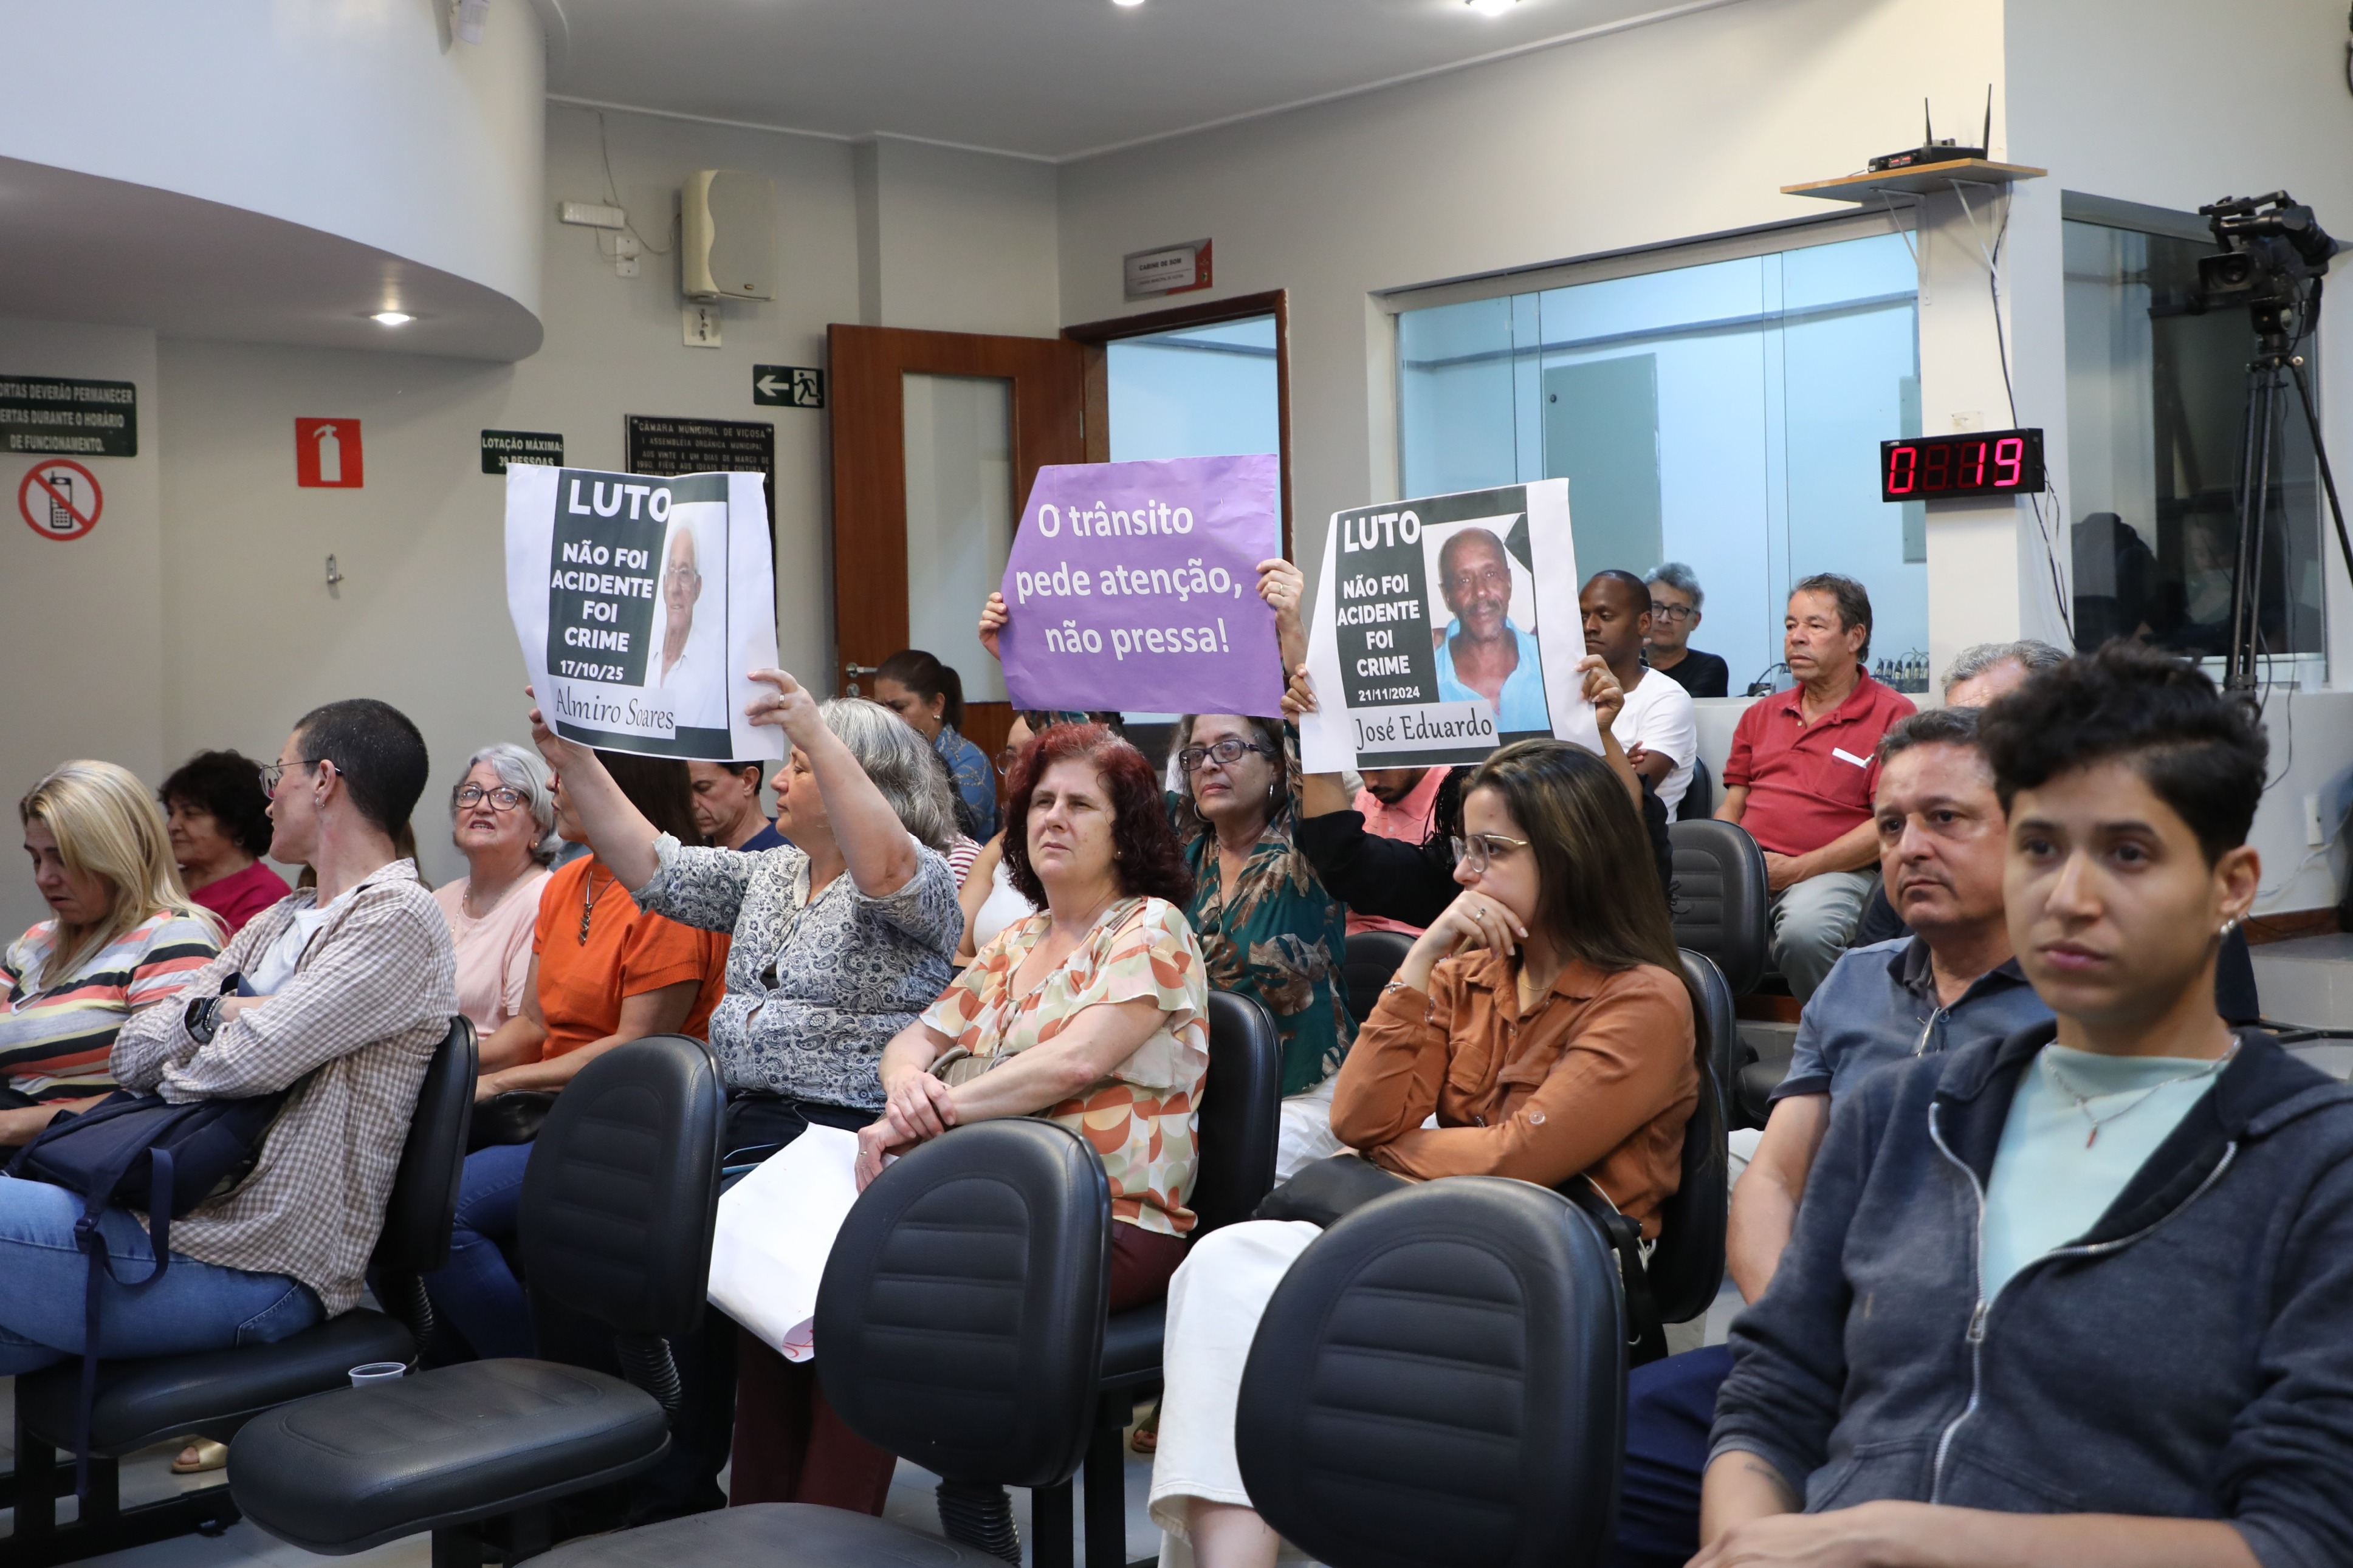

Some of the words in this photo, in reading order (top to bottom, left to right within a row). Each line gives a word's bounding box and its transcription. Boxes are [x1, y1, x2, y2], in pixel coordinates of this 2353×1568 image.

[1169, 258, 1182, 266] SOM
[30, 383, 72, 400] DEVERÃO
[74, 387, 133, 403] PERMANECER
[31, 409, 74, 425] DURANTE
[75, 412, 83, 425] O
[84, 409, 125, 428] HORÁRIO
[639, 420, 674, 433] CÂMARA
[678, 425, 718, 436] MUNICIPAL
[723, 427, 732, 436] DE
[10, 434, 23, 448] DE
[483, 437, 523, 451] LOTAÇÃO
[525, 438, 563, 451] MÁXIMA:
[730, 442, 763, 451] MUNICIPAL
[510, 456, 554, 467] PESSOAS
[568, 479, 672, 523] LUTO
[1038, 504, 1060, 538] O
[1068, 499, 1194, 536] trânsito
[1344, 510, 1421, 553] LUTO
[562, 539, 610, 566] NÃO
[614, 548, 648, 570] FOI
[551, 570, 654, 598] ACIDENTE
[1016, 561, 1091, 604] pede
[1099, 558, 1242, 602] atenção,
[1343, 575, 1378, 600] NÃO
[1381, 573, 1409, 594] FOI
[582, 600, 617, 623] FOI
[1337, 600, 1421, 627] ACIDENTE
[564, 626, 630, 652] CRIME
[1045, 620, 1102, 654] não
[1110, 617, 1229, 661] pressa!
[1365, 629, 1394, 650] FOI
[560, 659, 624, 681] 17/10/25
[1356, 655, 1411, 677] CRIME
[1358, 686, 1420, 702] 21/11/2024
[556, 685, 620, 724] Almiro
[625, 698, 674, 730] Soares
[1355, 716, 1396, 750] José
[1400, 707, 1493, 741] Eduardo
